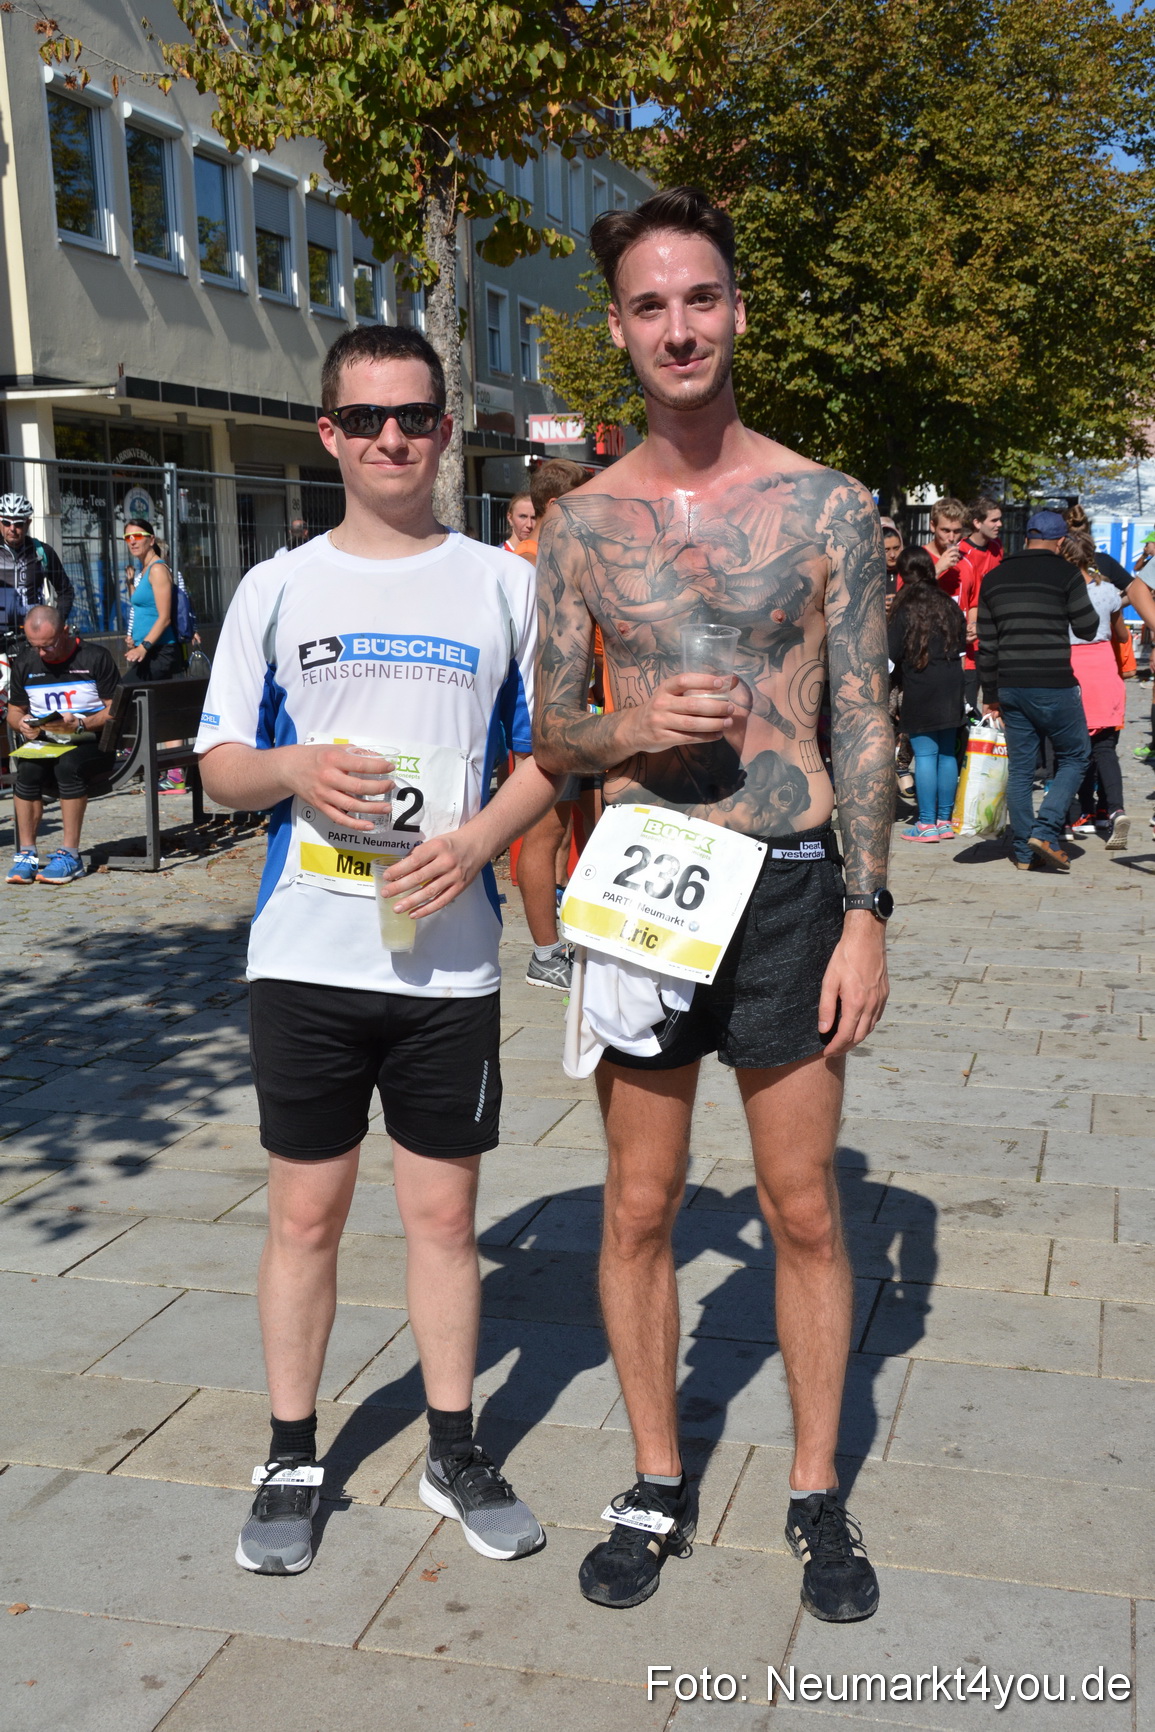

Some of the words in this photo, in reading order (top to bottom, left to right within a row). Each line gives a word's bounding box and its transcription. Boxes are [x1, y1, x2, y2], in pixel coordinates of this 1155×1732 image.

[476, 385, 491, 404] Foto
[531, 419, 583, 440] NKD
[352, 637, 473, 668] BÜSCHEL
[302, 661, 476, 692] FEINSCHNEIDTEAM
[328, 831, 361, 845] PARTL
[362, 837, 411, 850] Neumarkt
[642, 818, 716, 855] BOCK
[802, 841, 821, 850] beat
[612, 844, 710, 911] 236
[637, 902, 685, 927] Neumarkt
